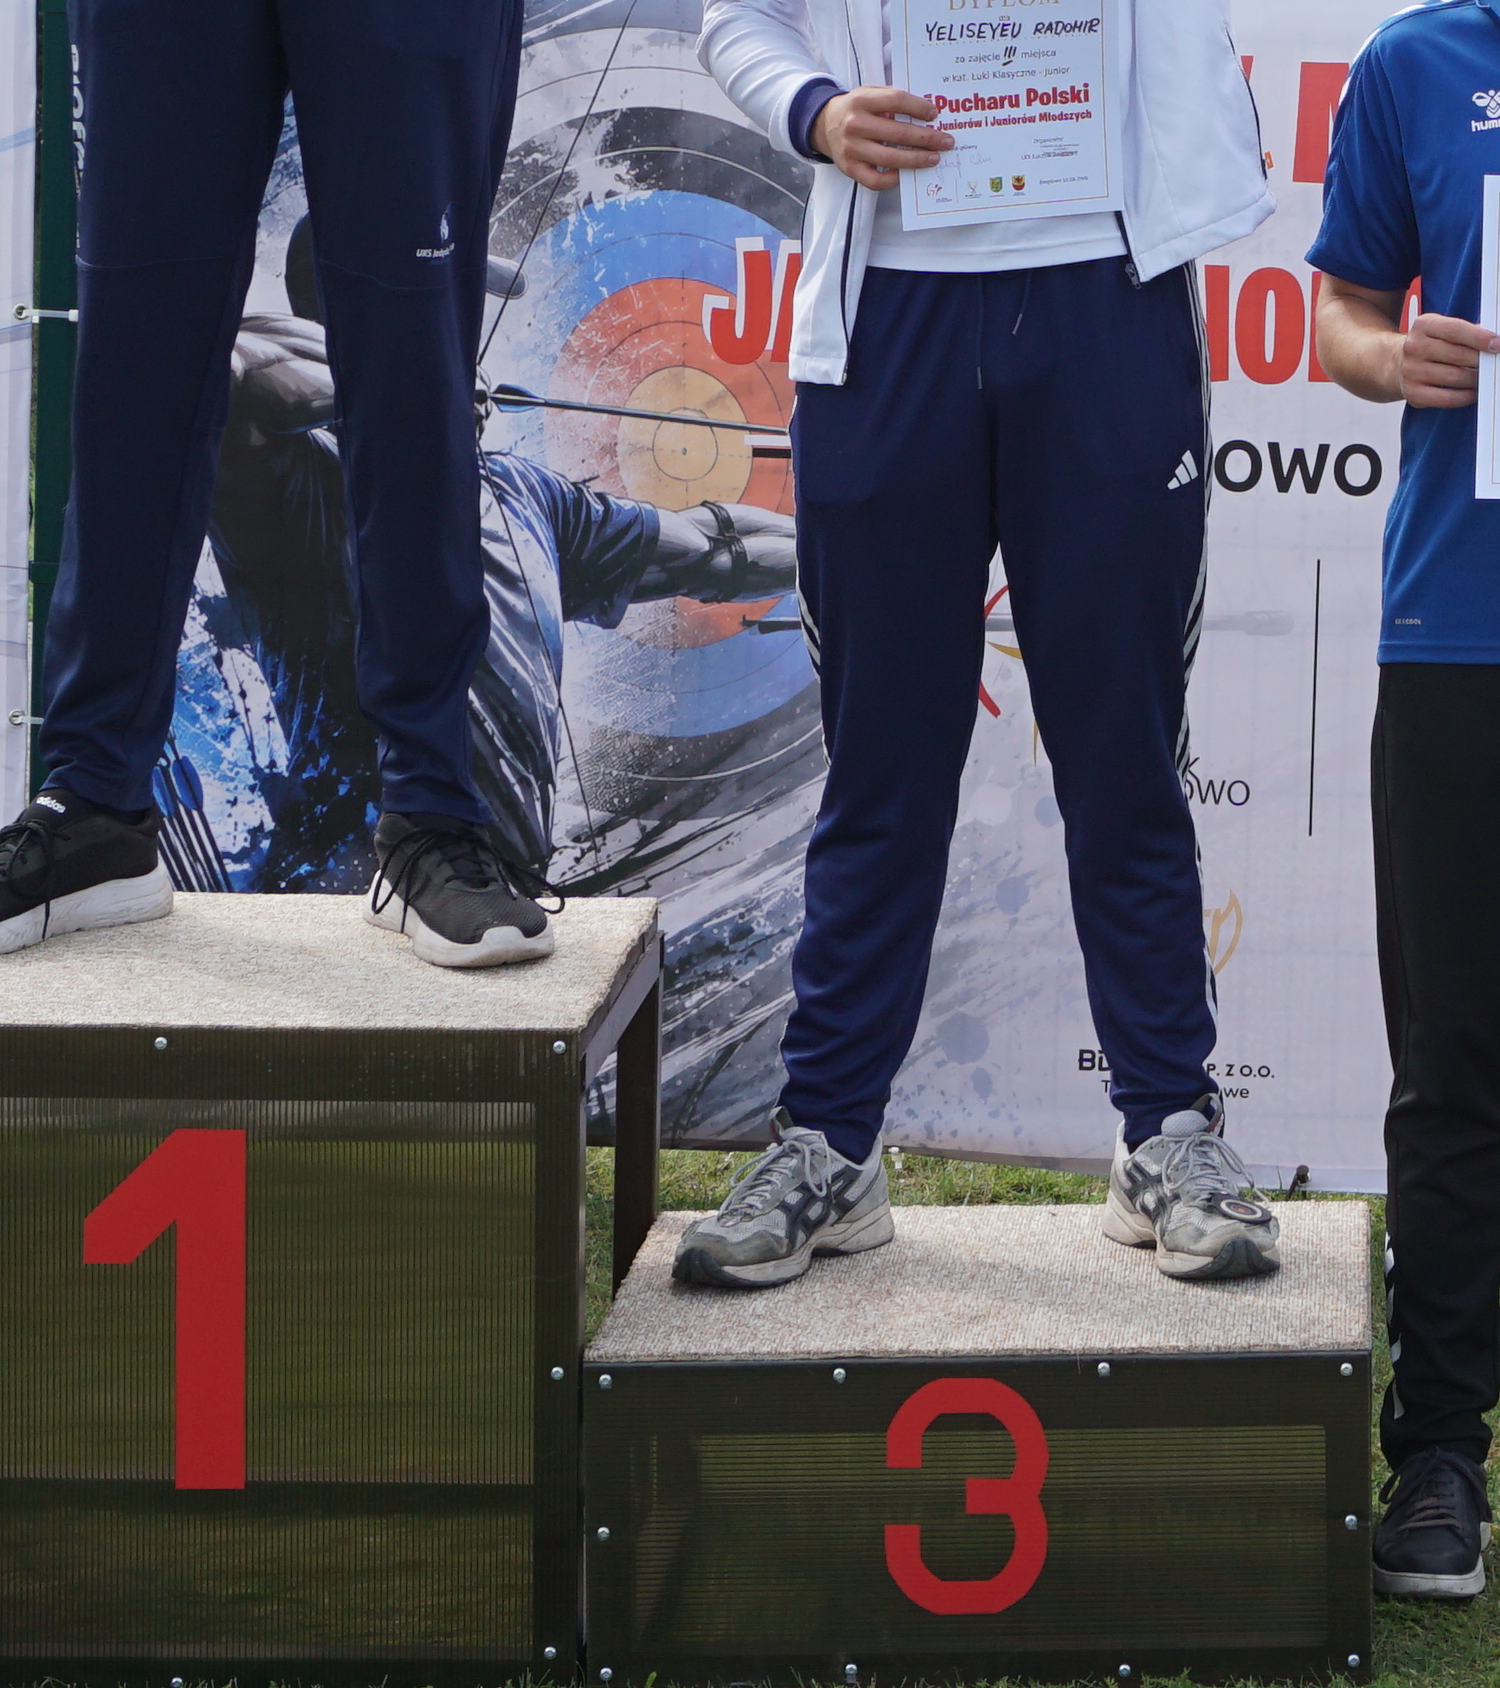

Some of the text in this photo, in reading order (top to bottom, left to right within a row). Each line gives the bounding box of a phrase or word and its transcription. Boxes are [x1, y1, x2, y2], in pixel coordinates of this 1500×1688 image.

[1033, 17, 1101, 35] RADOMIR
[935, 83, 1091, 115] Pucharu Polski
[937, 109, 1093, 132] Juniorów i Juniorów Młodszych
[84, 1129, 246, 1489] 1
[886, 1378, 1049, 1614] 3
